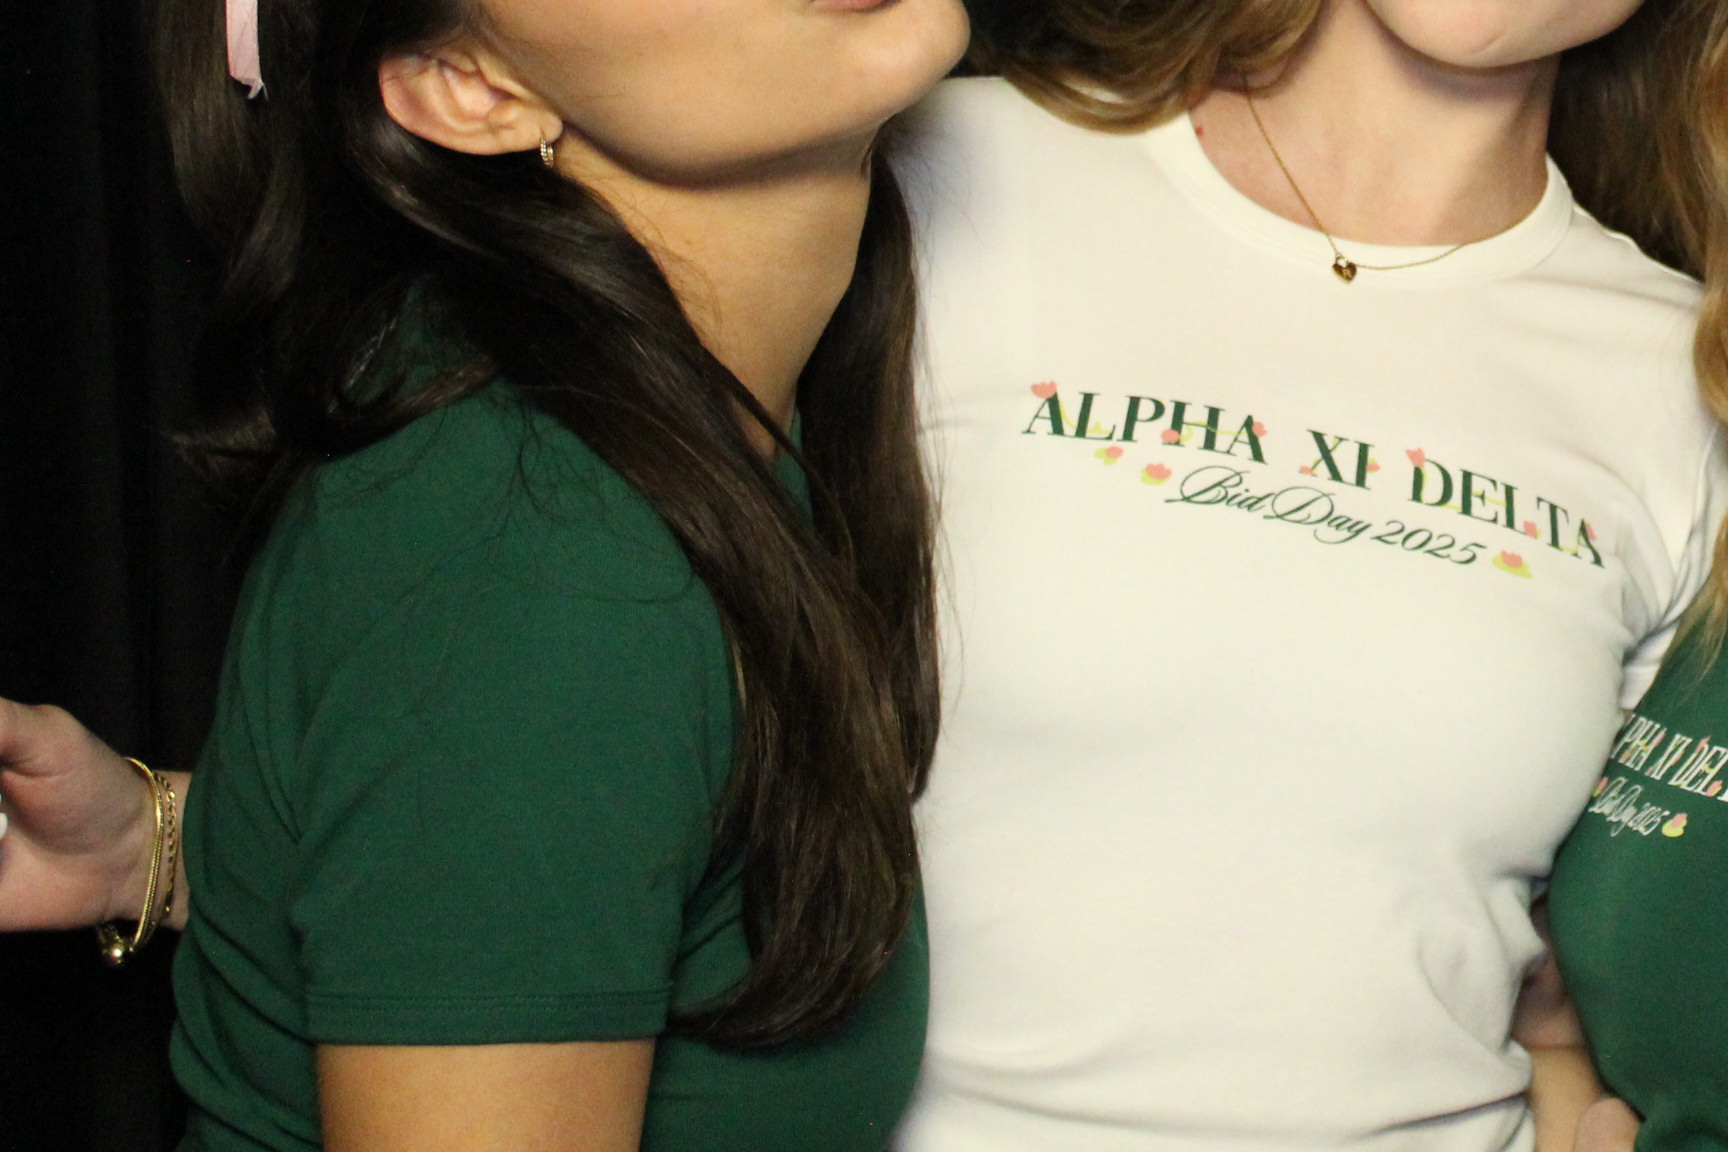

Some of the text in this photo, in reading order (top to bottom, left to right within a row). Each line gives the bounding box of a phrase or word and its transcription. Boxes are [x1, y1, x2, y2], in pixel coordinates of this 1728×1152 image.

[1022, 389, 1605, 569] ALPHA XI DELTA
[1164, 465, 1488, 565] Bid Day 2025
